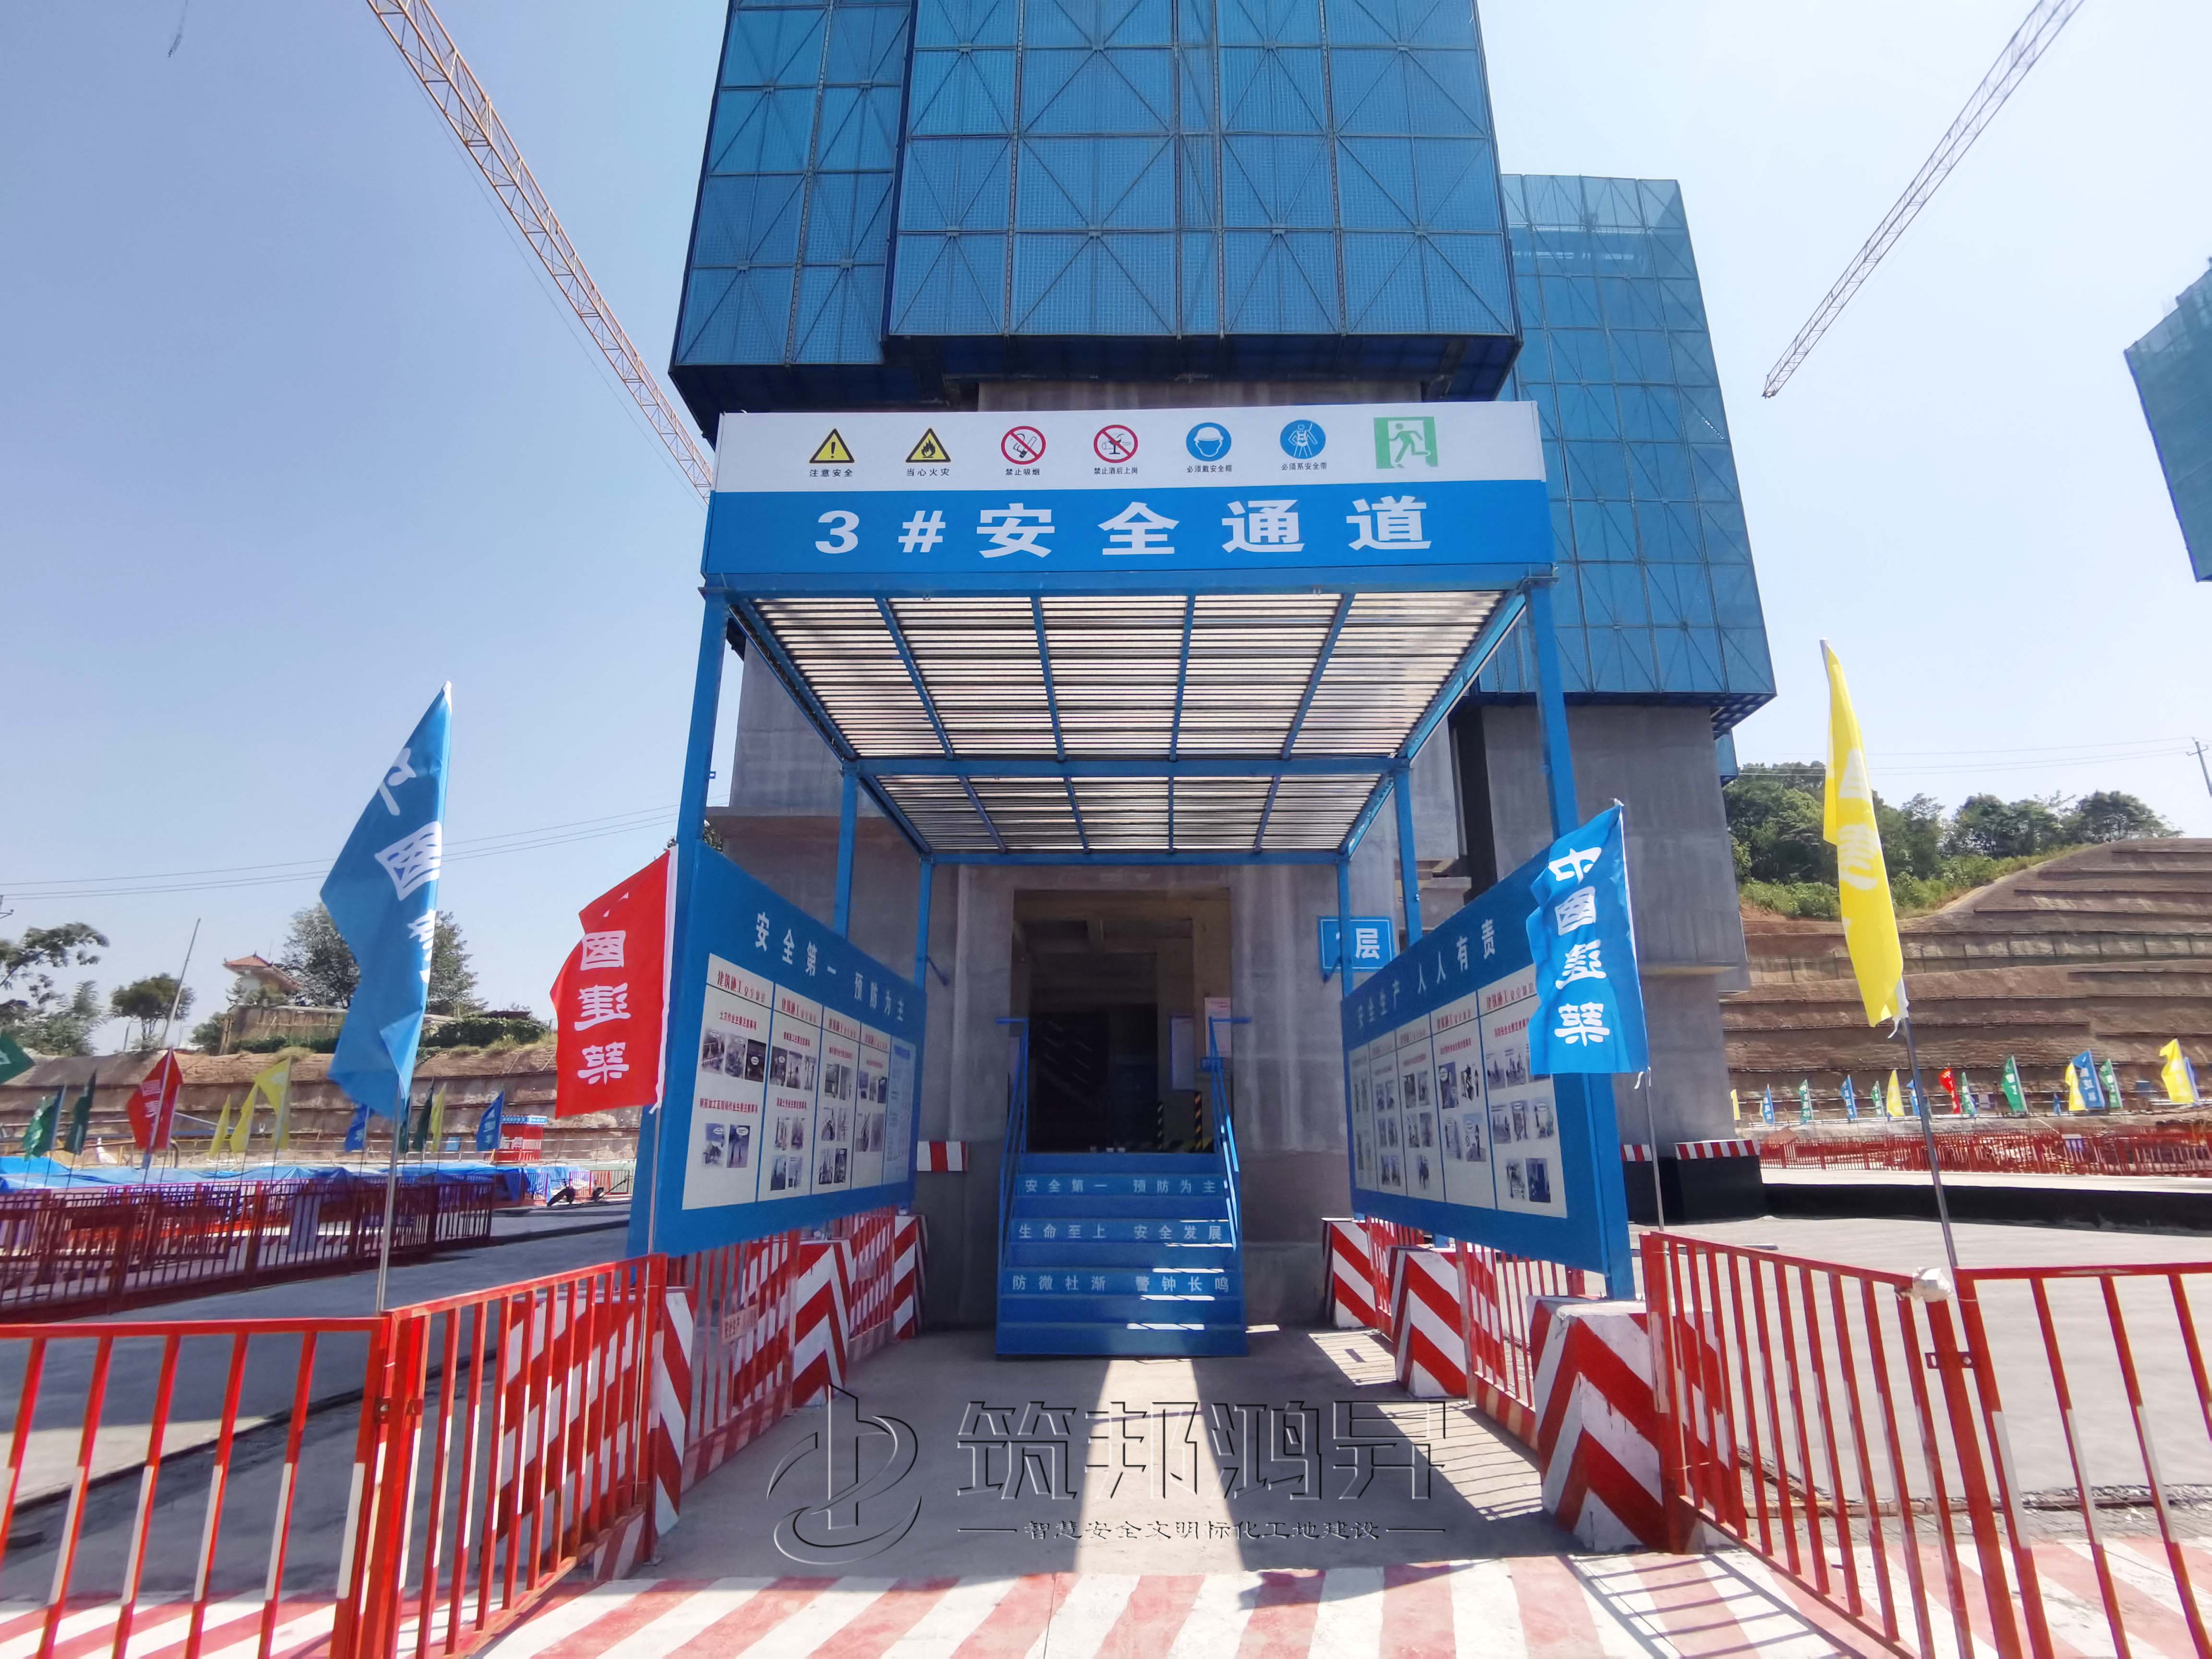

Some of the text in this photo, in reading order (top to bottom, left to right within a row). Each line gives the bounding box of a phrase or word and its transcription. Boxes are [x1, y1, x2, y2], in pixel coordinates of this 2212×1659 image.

[1094, 467, 1138, 475] 禁止酒后上岗
[1187, 464, 1233, 473] 必须戴安全帽
[1281, 462, 1328, 471] 必须系安全带
[809, 468, 854, 478] 注意安全
[906, 468, 950, 477] 当心火灾
[1005, 468, 1040, 476] 禁止吸烟
[1418, 918, 1495, 995] 人人有责
[756, 912, 837, 977] 安全第一
[854, 972, 904, 1022] 预防为主
[1025, 1178, 1216, 1193] 安全第一 预防为主
[1019, 1223, 1221, 1240] 生命至上 安全发展
[1012, 1274, 1229, 1292] 防微杜渐 警钟长鸣
